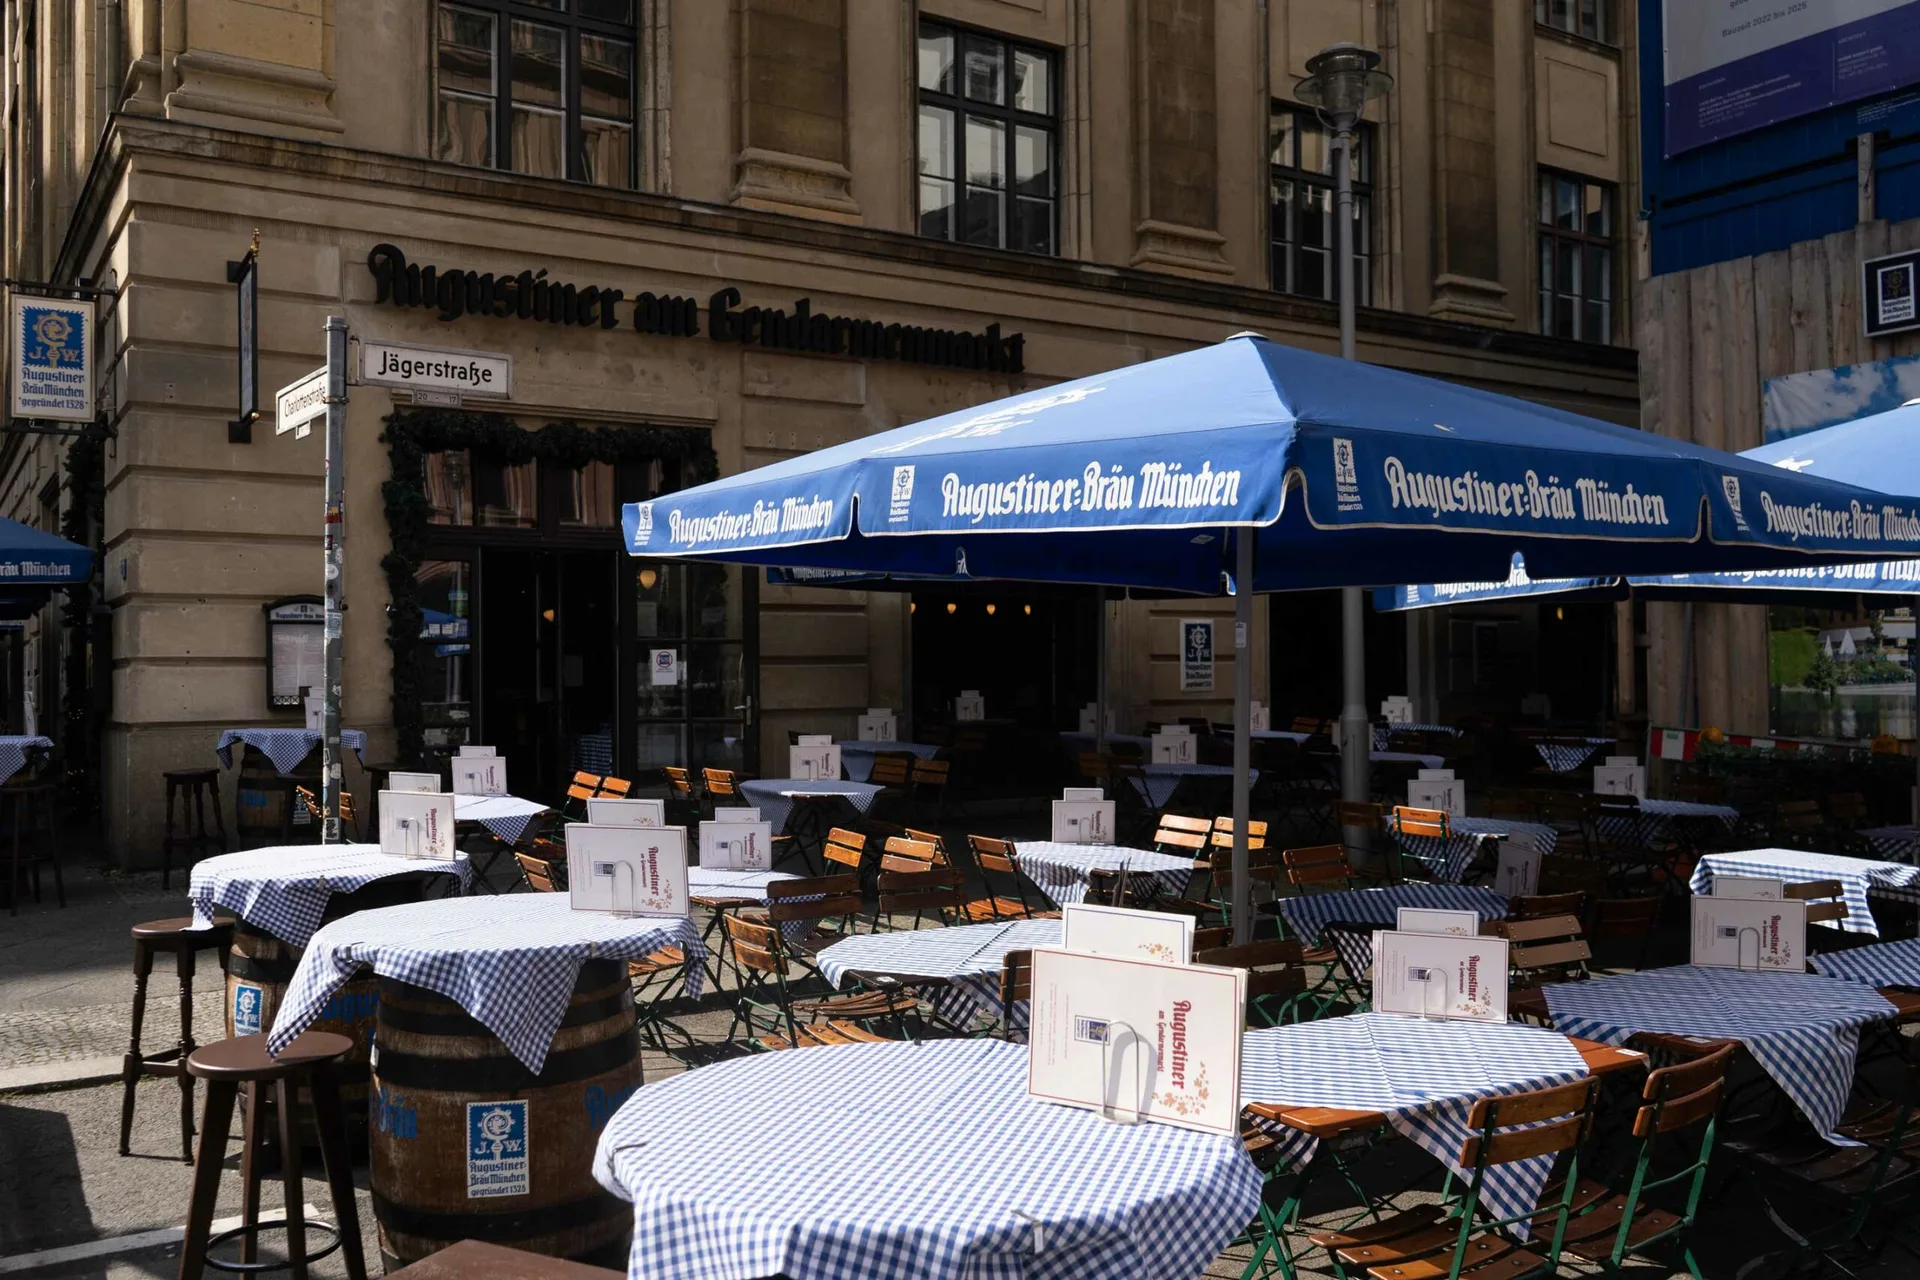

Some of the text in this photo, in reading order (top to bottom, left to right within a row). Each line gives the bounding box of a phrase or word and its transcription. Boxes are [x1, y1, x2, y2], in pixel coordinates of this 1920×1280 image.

[1722, 22, 1750, 37] Bauzeit
[1752, 14, 1772, 26] 2022
[367, 243, 624, 330] Augustiner
[633, 291, 700, 338] am
[377, 350, 492, 387] Jägerstraße
[21, 398, 65, 409] gegründet
[1138, 460, 1242, 509] München
[1575, 478, 1669, 526] München
[781, 494, 834, 533] München
[20, 560, 72, 577] München
[647, 845, 659, 896] Augustiner
[1770, 914, 1781, 955] Augustiner
[1467, 954, 1480, 1002] Augustiner
[1171, 1000, 1192, 1089] Augustiner
[469, 1173, 526, 1187] Bräu München
[470, 1186, 510, 1197] gegründet
